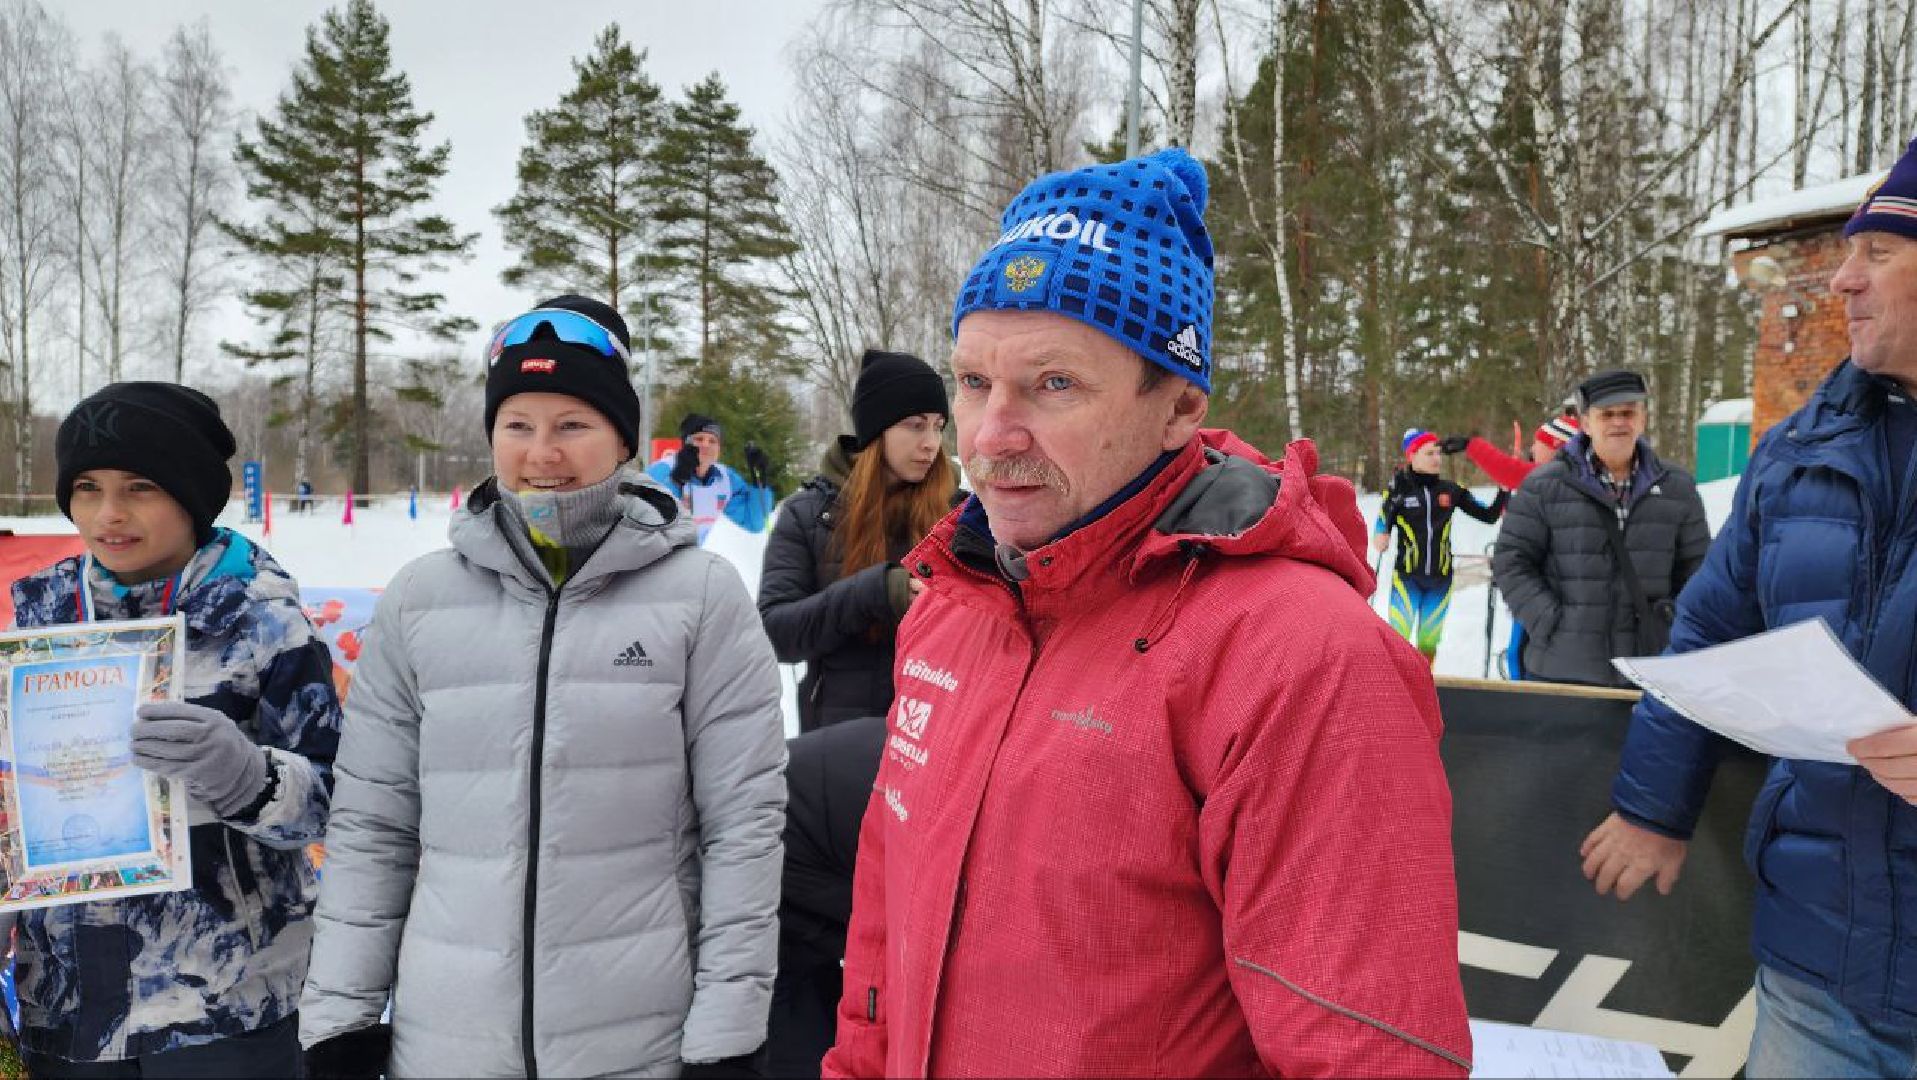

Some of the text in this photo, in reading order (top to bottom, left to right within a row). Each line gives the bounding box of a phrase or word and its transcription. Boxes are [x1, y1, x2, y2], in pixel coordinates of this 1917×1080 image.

[1167, 340, 1202, 366] adidas
[613, 656, 653, 667] adidas
[24, 666, 124, 694] ГРАМОТА
